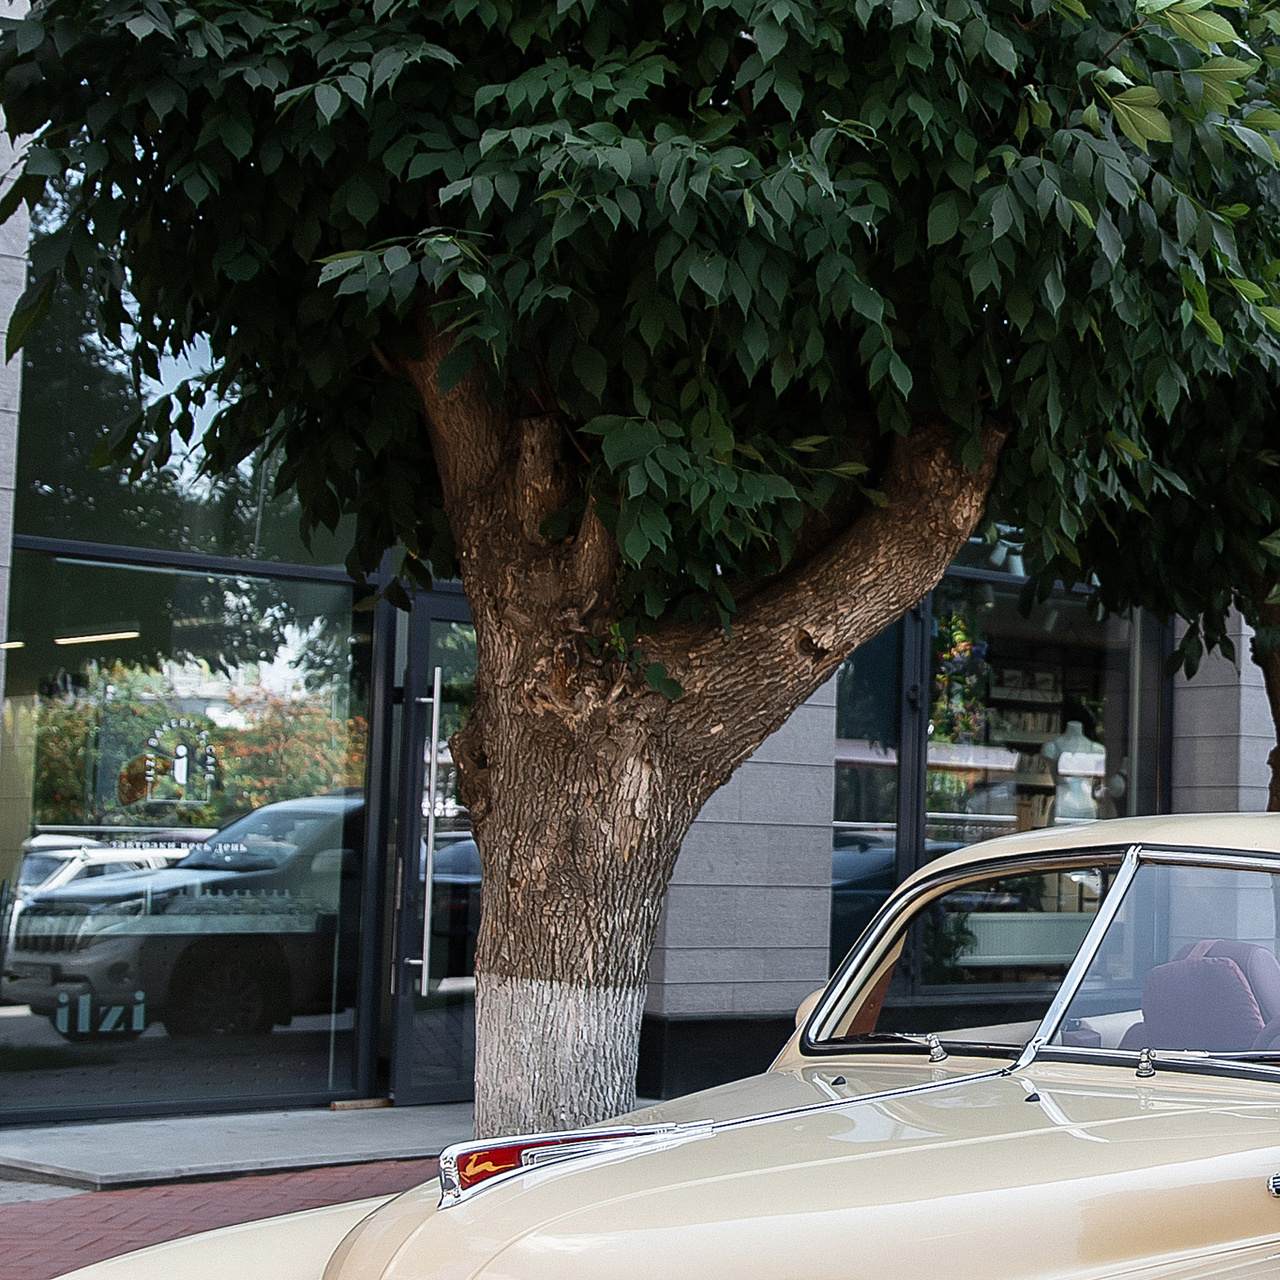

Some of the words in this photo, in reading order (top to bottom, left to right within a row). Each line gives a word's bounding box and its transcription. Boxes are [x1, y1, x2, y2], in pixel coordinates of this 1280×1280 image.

[148, 718, 196, 748] BAKERY
[204, 744, 216, 782] CAFE
[56, 989, 145, 1033] ilzi
